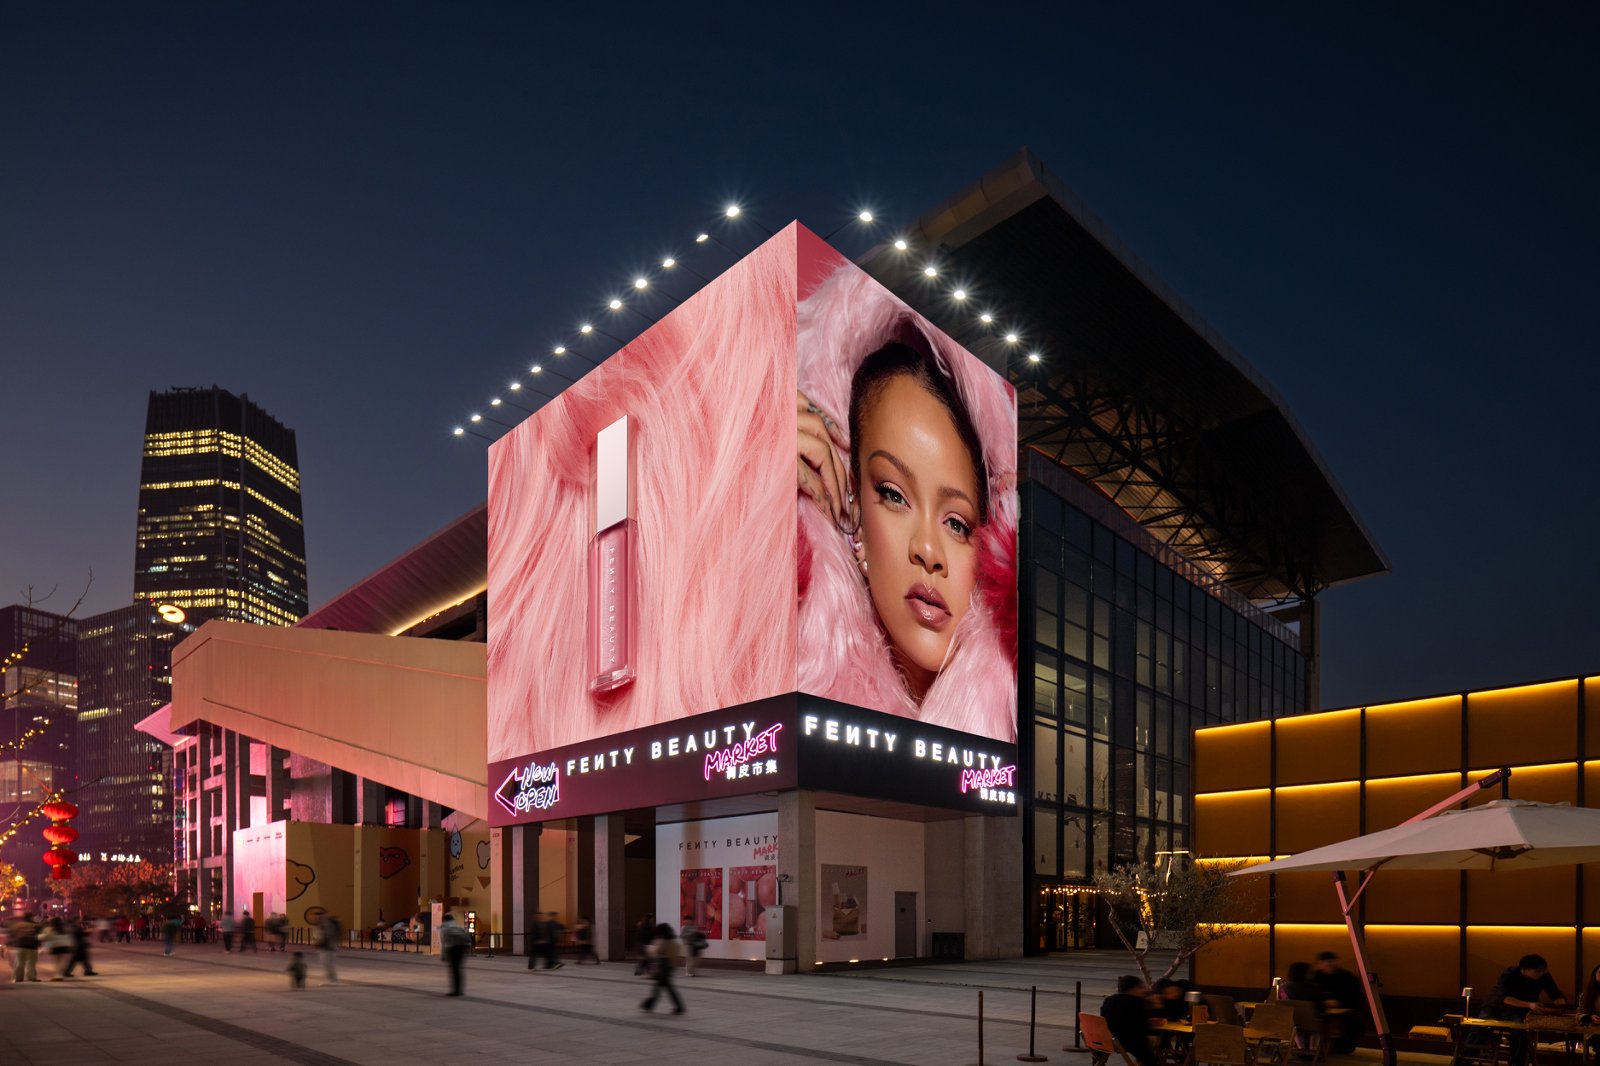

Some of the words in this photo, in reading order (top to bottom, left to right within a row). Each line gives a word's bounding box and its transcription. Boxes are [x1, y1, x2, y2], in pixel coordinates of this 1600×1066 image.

[651, 721, 756, 760] BEAUTY
[704, 723, 783, 781] MARKET
[915, 739, 1001, 771] BEAUTY
[961, 765, 1016, 793] MARKET
[516, 784, 558, 813] OPEN
[726, 835, 778, 847] BEAUTY
[753, 842, 778, 860] MARK
